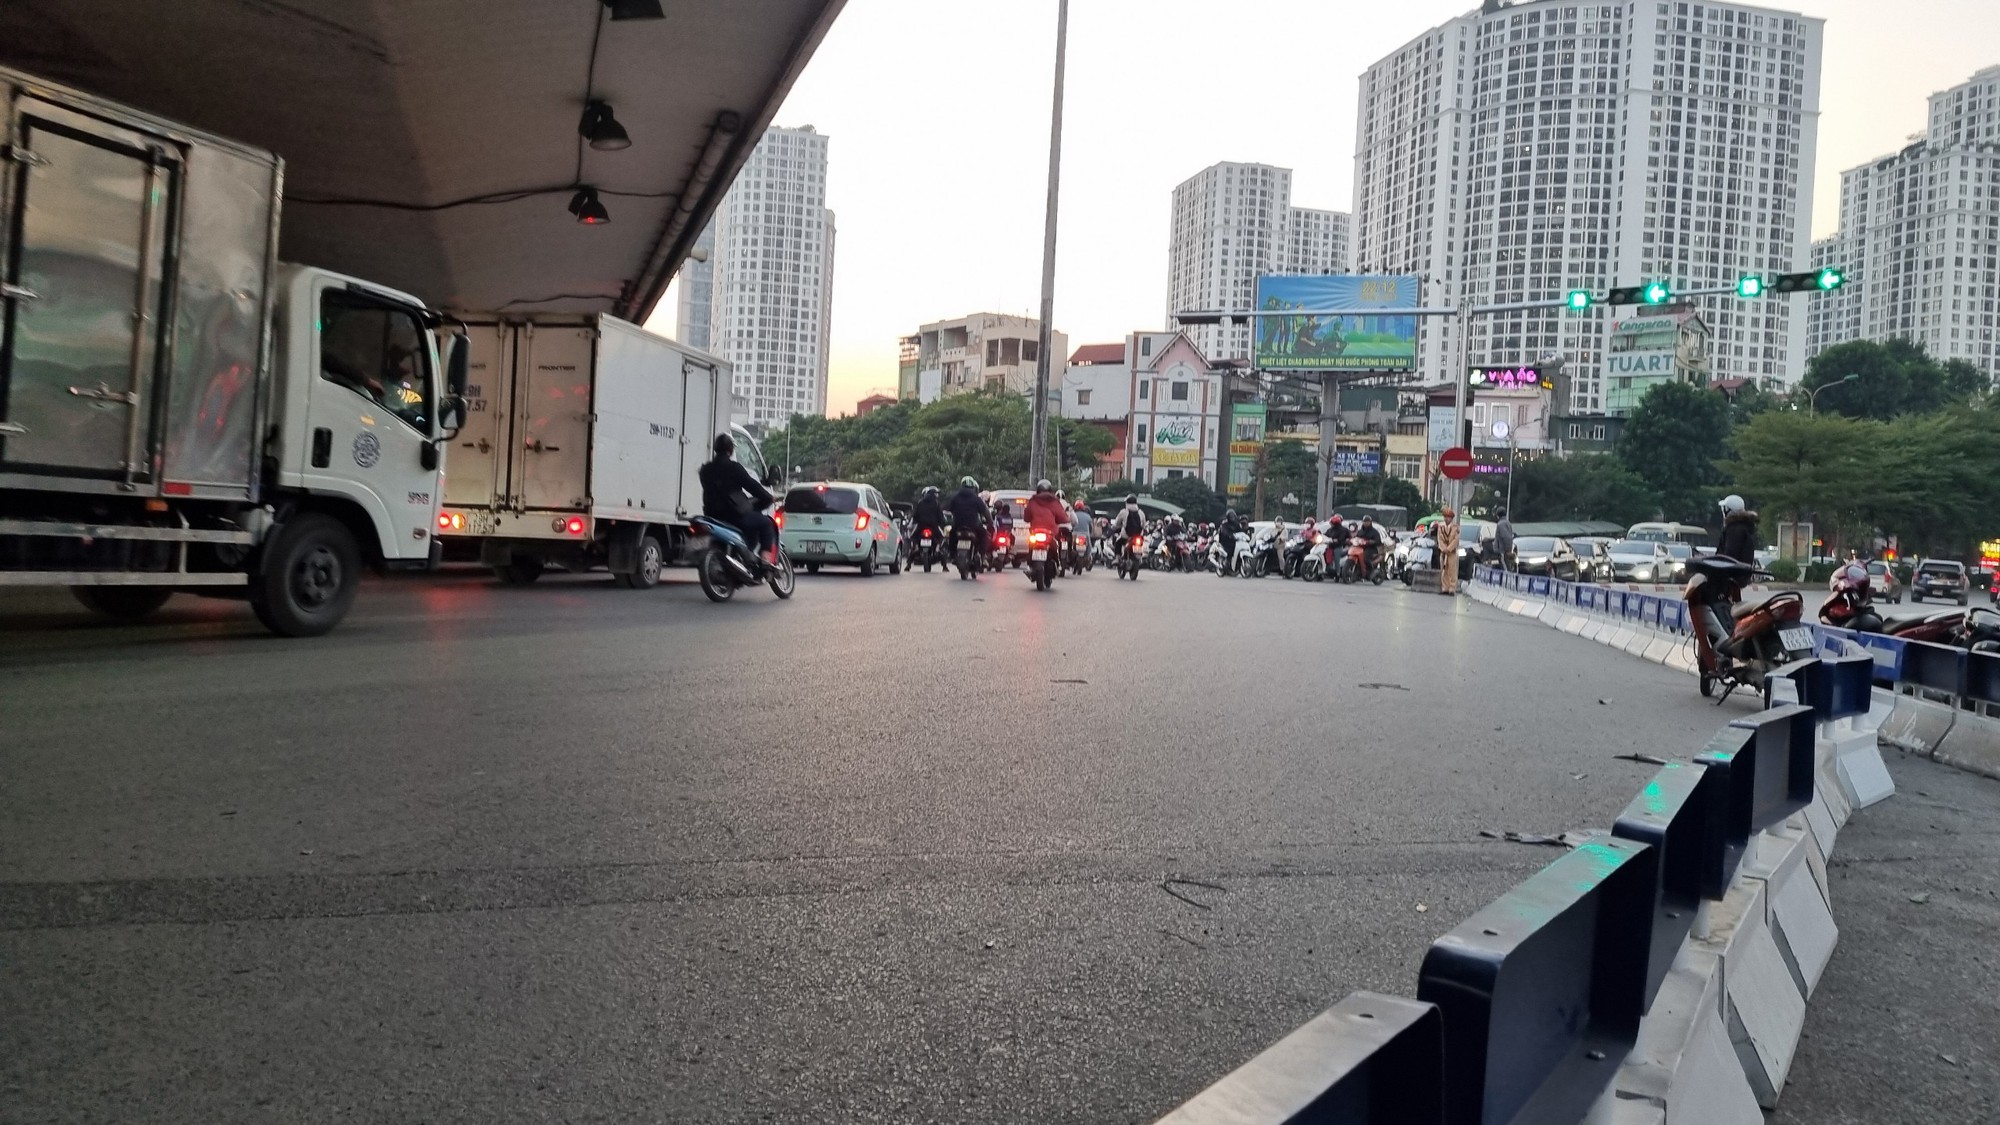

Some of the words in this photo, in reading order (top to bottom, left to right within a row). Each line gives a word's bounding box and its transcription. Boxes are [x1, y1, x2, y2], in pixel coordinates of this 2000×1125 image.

[1607, 354, 1673, 373] TUART
[465, 385, 481, 397] 9H
[467, 400, 487, 411] 7.57
